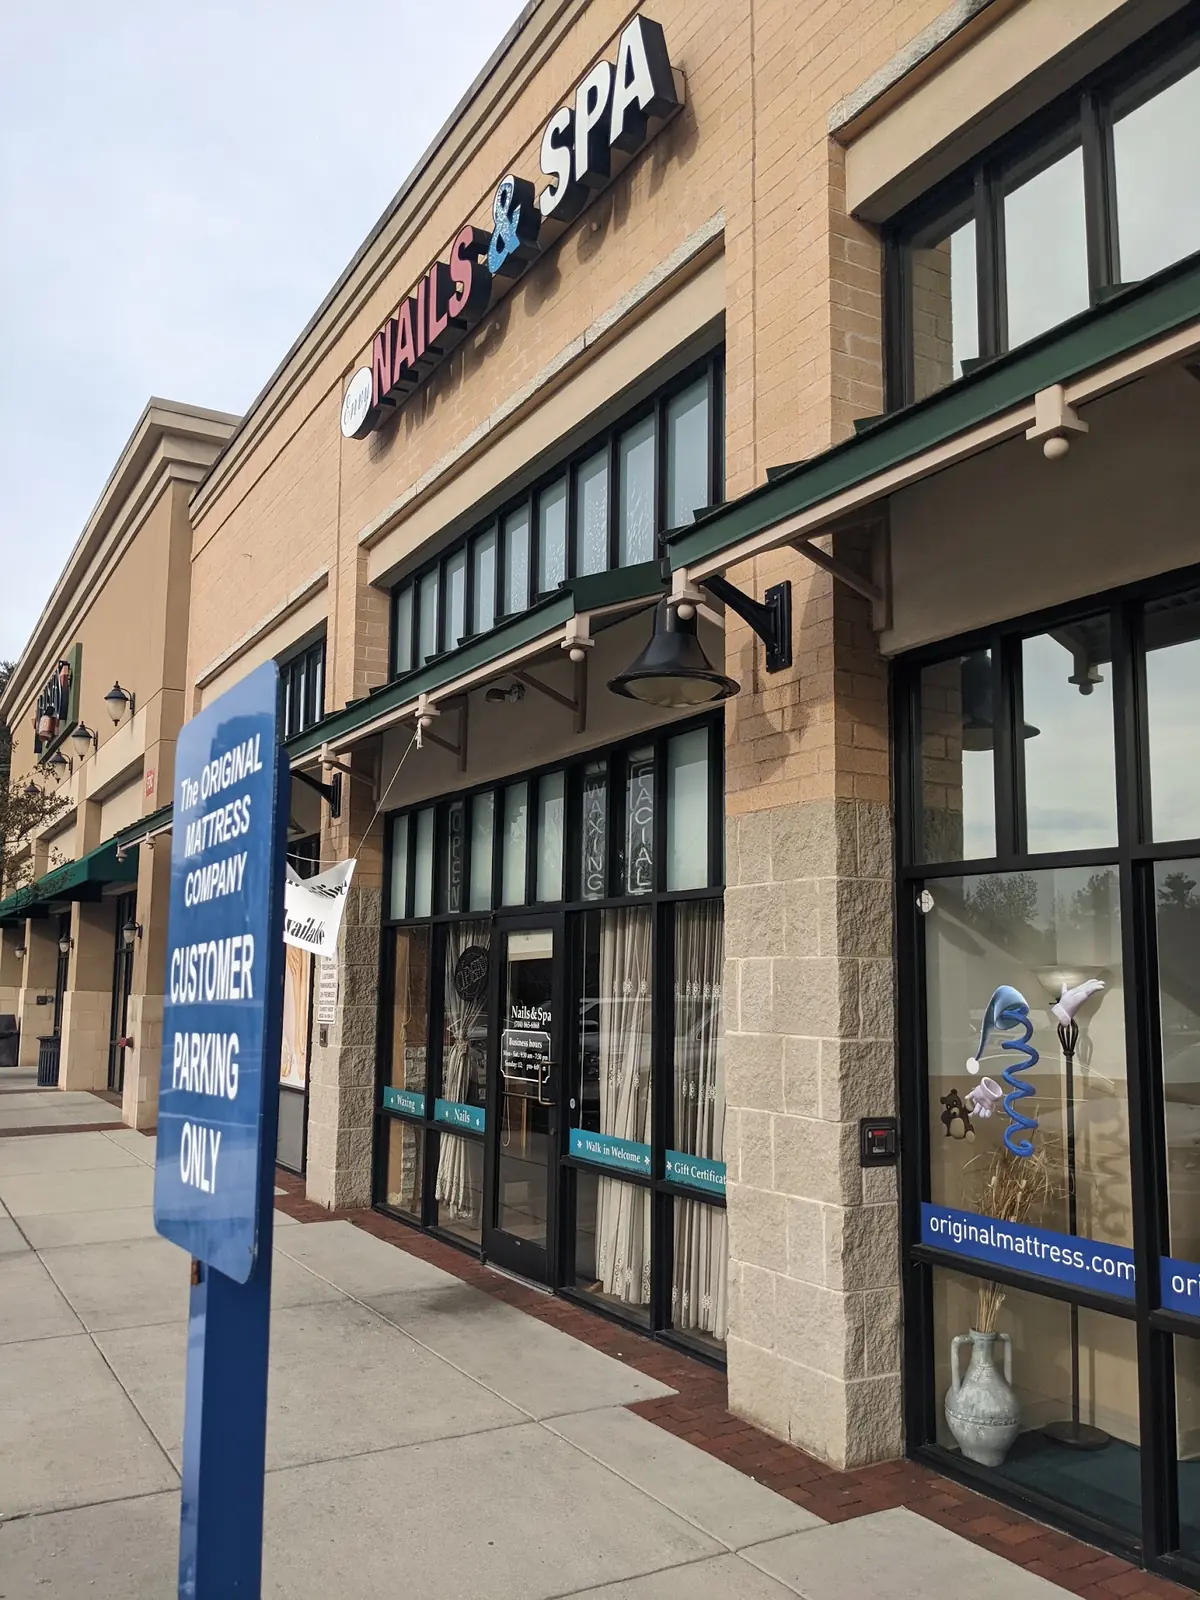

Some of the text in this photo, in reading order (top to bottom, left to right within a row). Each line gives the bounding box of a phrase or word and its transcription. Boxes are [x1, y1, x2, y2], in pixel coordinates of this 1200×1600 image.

[372, 13, 656, 408] NAILS & SPA
[180, 733, 263, 812] The ORIGINAL
[184, 794, 252, 858] MATTRESS
[587, 781, 606, 891] WAXING
[634, 767, 653, 886] FACIAL
[184, 851, 248, 907] COMPANY
[170, 933, 255, 1004] CUSTOMER
[172, 1031, 240, 1100] PARKING
[509, 1037, 542, 1048] Business hours
[397, 1094, 416, 1113] Waxing
[454, 1108, 470, 1124] Nails
[179, 1121, 222, 1194] ONLY
[586, 1140, 641, 1164] Walk in Welcome
[674, 1162, 690, 1177] Gift
[930, 1214, 1136, 1282] originalmattress.com
